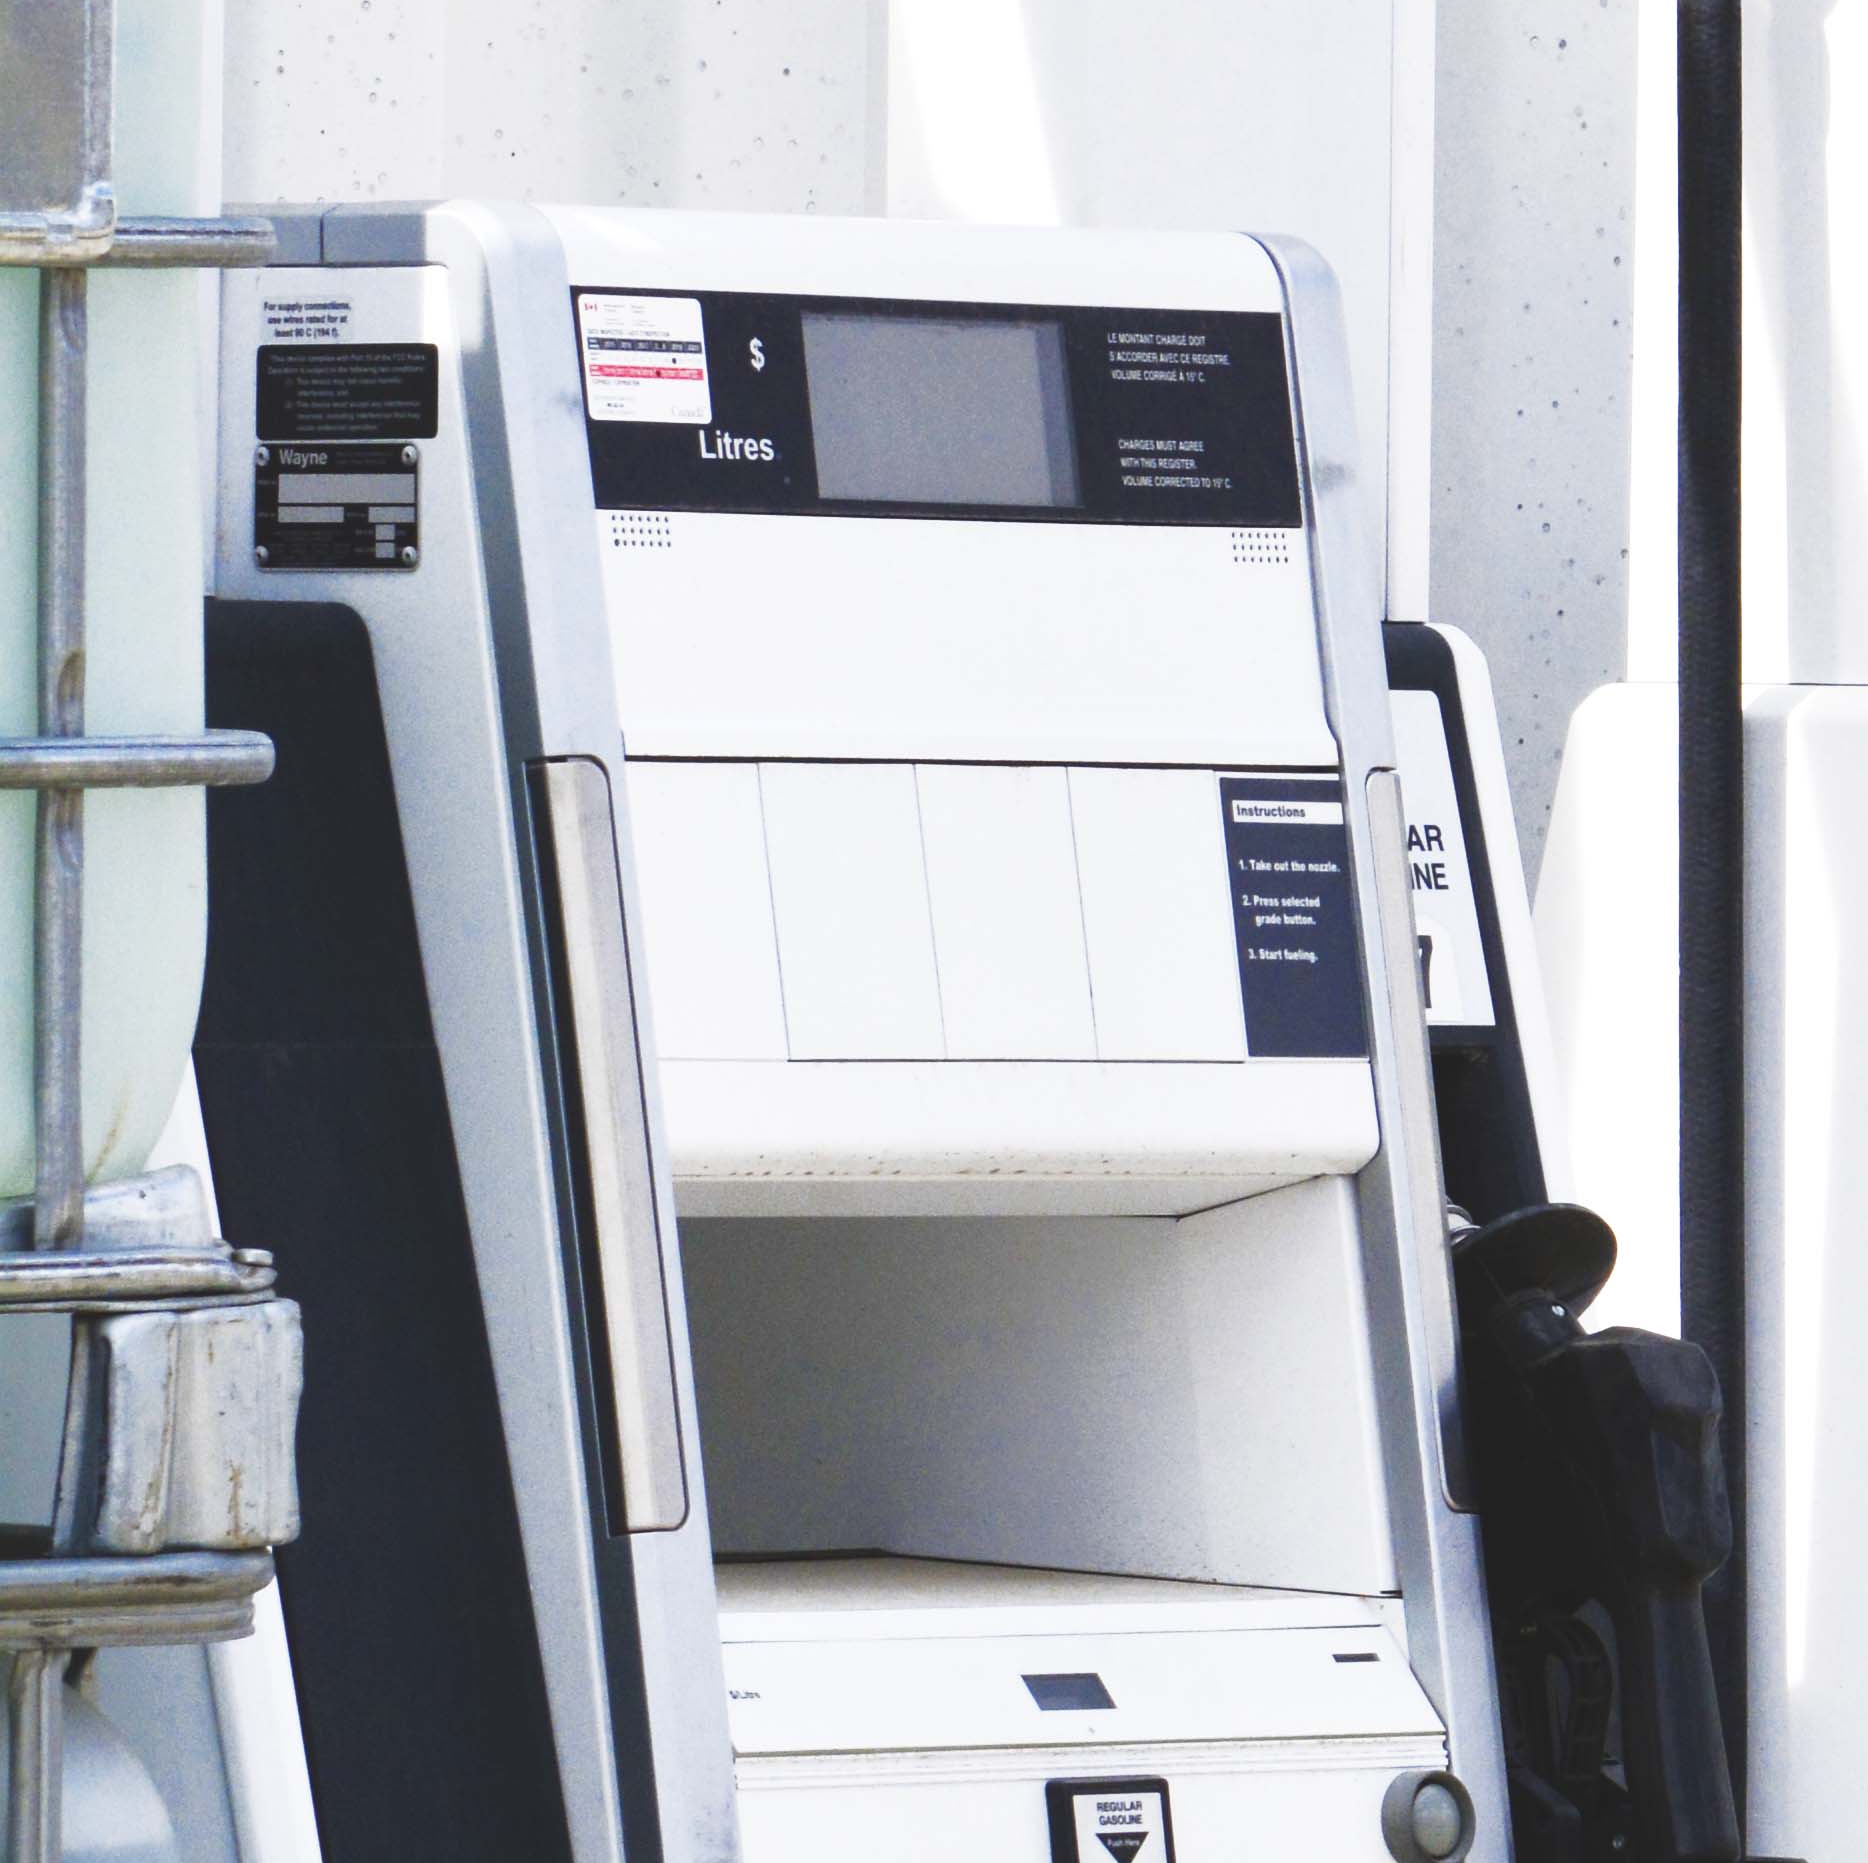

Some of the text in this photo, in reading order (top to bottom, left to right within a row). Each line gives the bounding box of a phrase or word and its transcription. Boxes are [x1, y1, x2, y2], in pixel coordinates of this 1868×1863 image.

[278, 301, 302, 313] supply
[1107, 333, 1117, 344] LE
[1118, 333, 1154, 344] MONTANT
[1188, 335, 1206, 346] DOIT
[749, 336, 766, 371] $
[1160, 352, 1178, 363] AVEC
[1180, 353, 1190, 364] CE
[1111, 370, 1142, 380] VOLUME
[700, 429, 774, 462] Litres
[1118, 438, 1155, 450] CHARGES
[1156, 440, 1176, 451] MUST
[279, 449, 328, 468] Wayne
[1120, 458, 1140, 468] WITH
[1140, 458, 1157, 468] THIS
[1122, 476, 1152, 486] VOLUME
[1154, 476, 1200, 488] CORRECTED
[1201, 478, 1211, 488] TO
[1236, 804, 1306, 818] Instructions
[1238, 859, 1341, 873] 1. Take out the nozzle.
[1242, 895, 1320, 908] 2. Press selected
[1256, 914, 1316, 927] grade button.
[1258, 949, 1282, 960] Start
[1284, 949, 1318, 964] fueling.
[1096, 1800, 1143, 1812] REGULAR
[1098, 1814, 1143, 1826] GASOLINE
